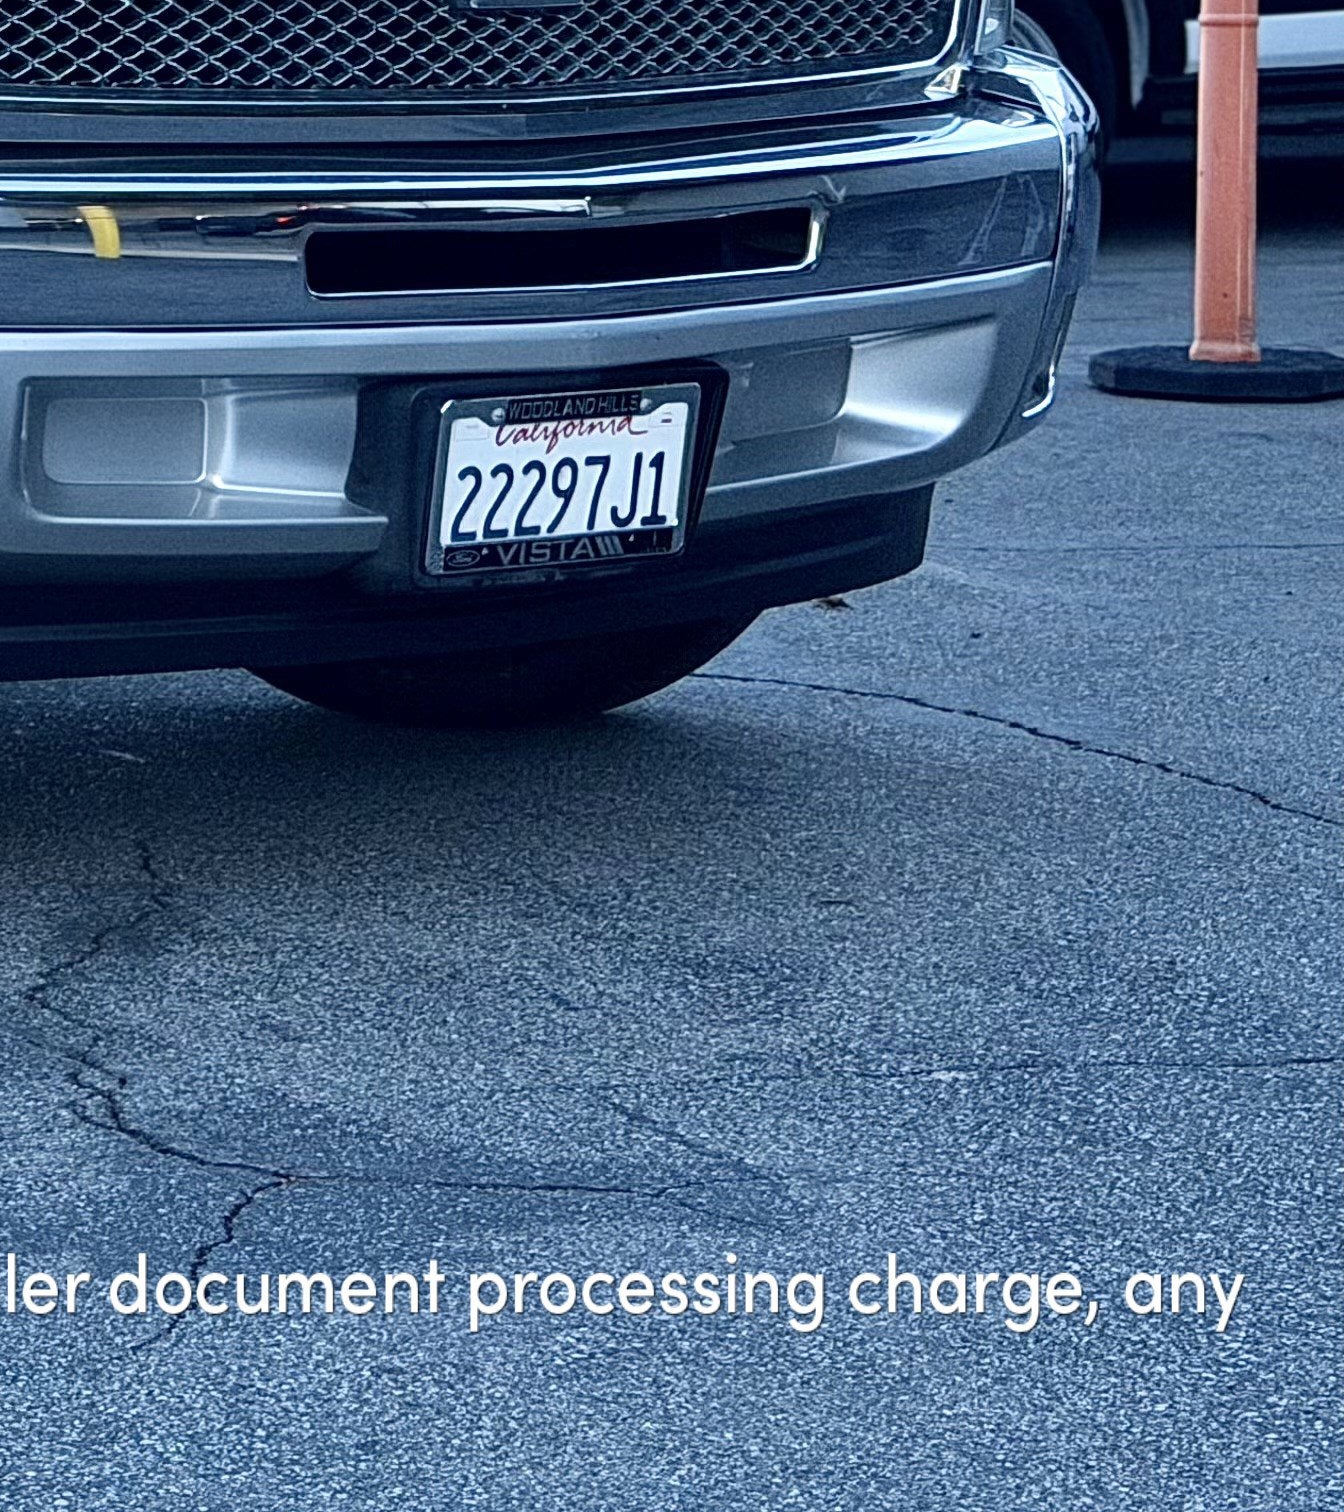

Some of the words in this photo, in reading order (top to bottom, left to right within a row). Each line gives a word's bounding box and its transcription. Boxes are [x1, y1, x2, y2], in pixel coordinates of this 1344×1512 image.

[509, 397, 596, 420] WOODLAND
[450, 451, 667, 543] 22297J1
[496, 536, 595, 565] VISTA
